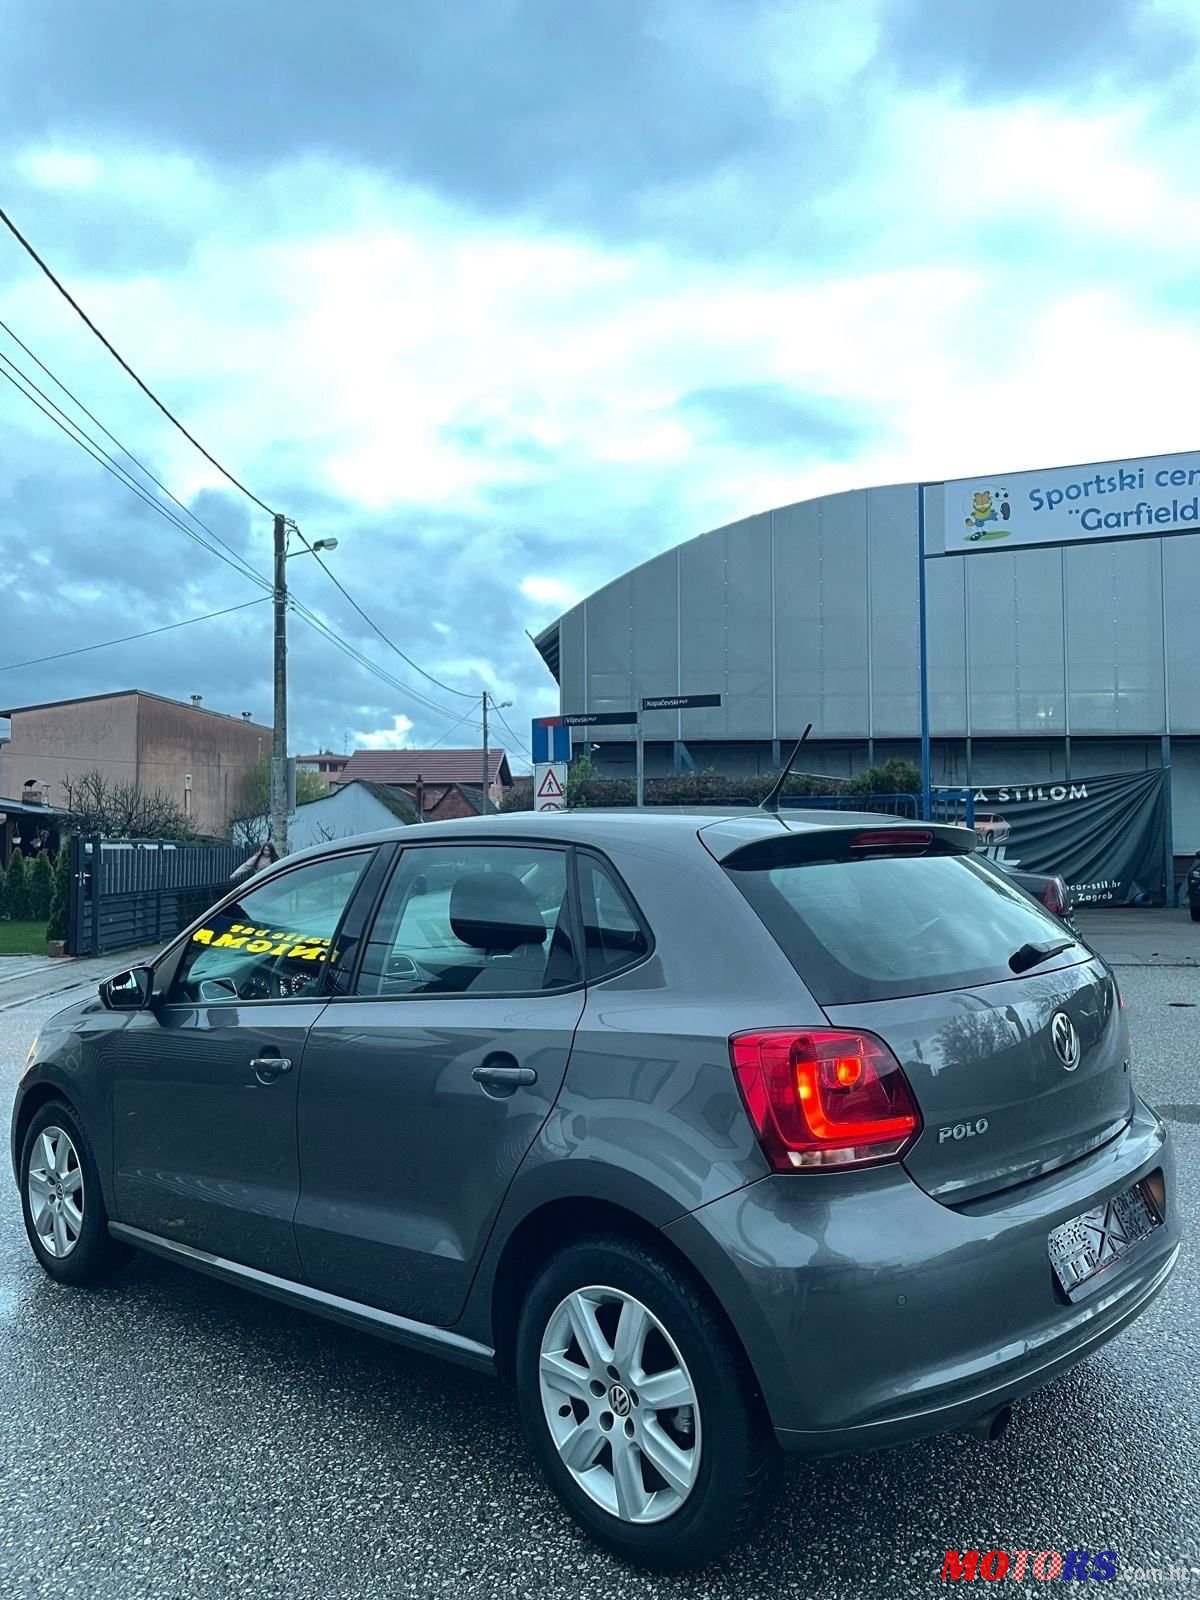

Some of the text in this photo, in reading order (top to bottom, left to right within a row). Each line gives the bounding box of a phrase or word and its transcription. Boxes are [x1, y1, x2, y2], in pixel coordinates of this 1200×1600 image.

[1029, 468, 1144, 511] Sportski
[998, 783, 1089, 801] STILOM
[938, 1118, 989, 1144] POLO
